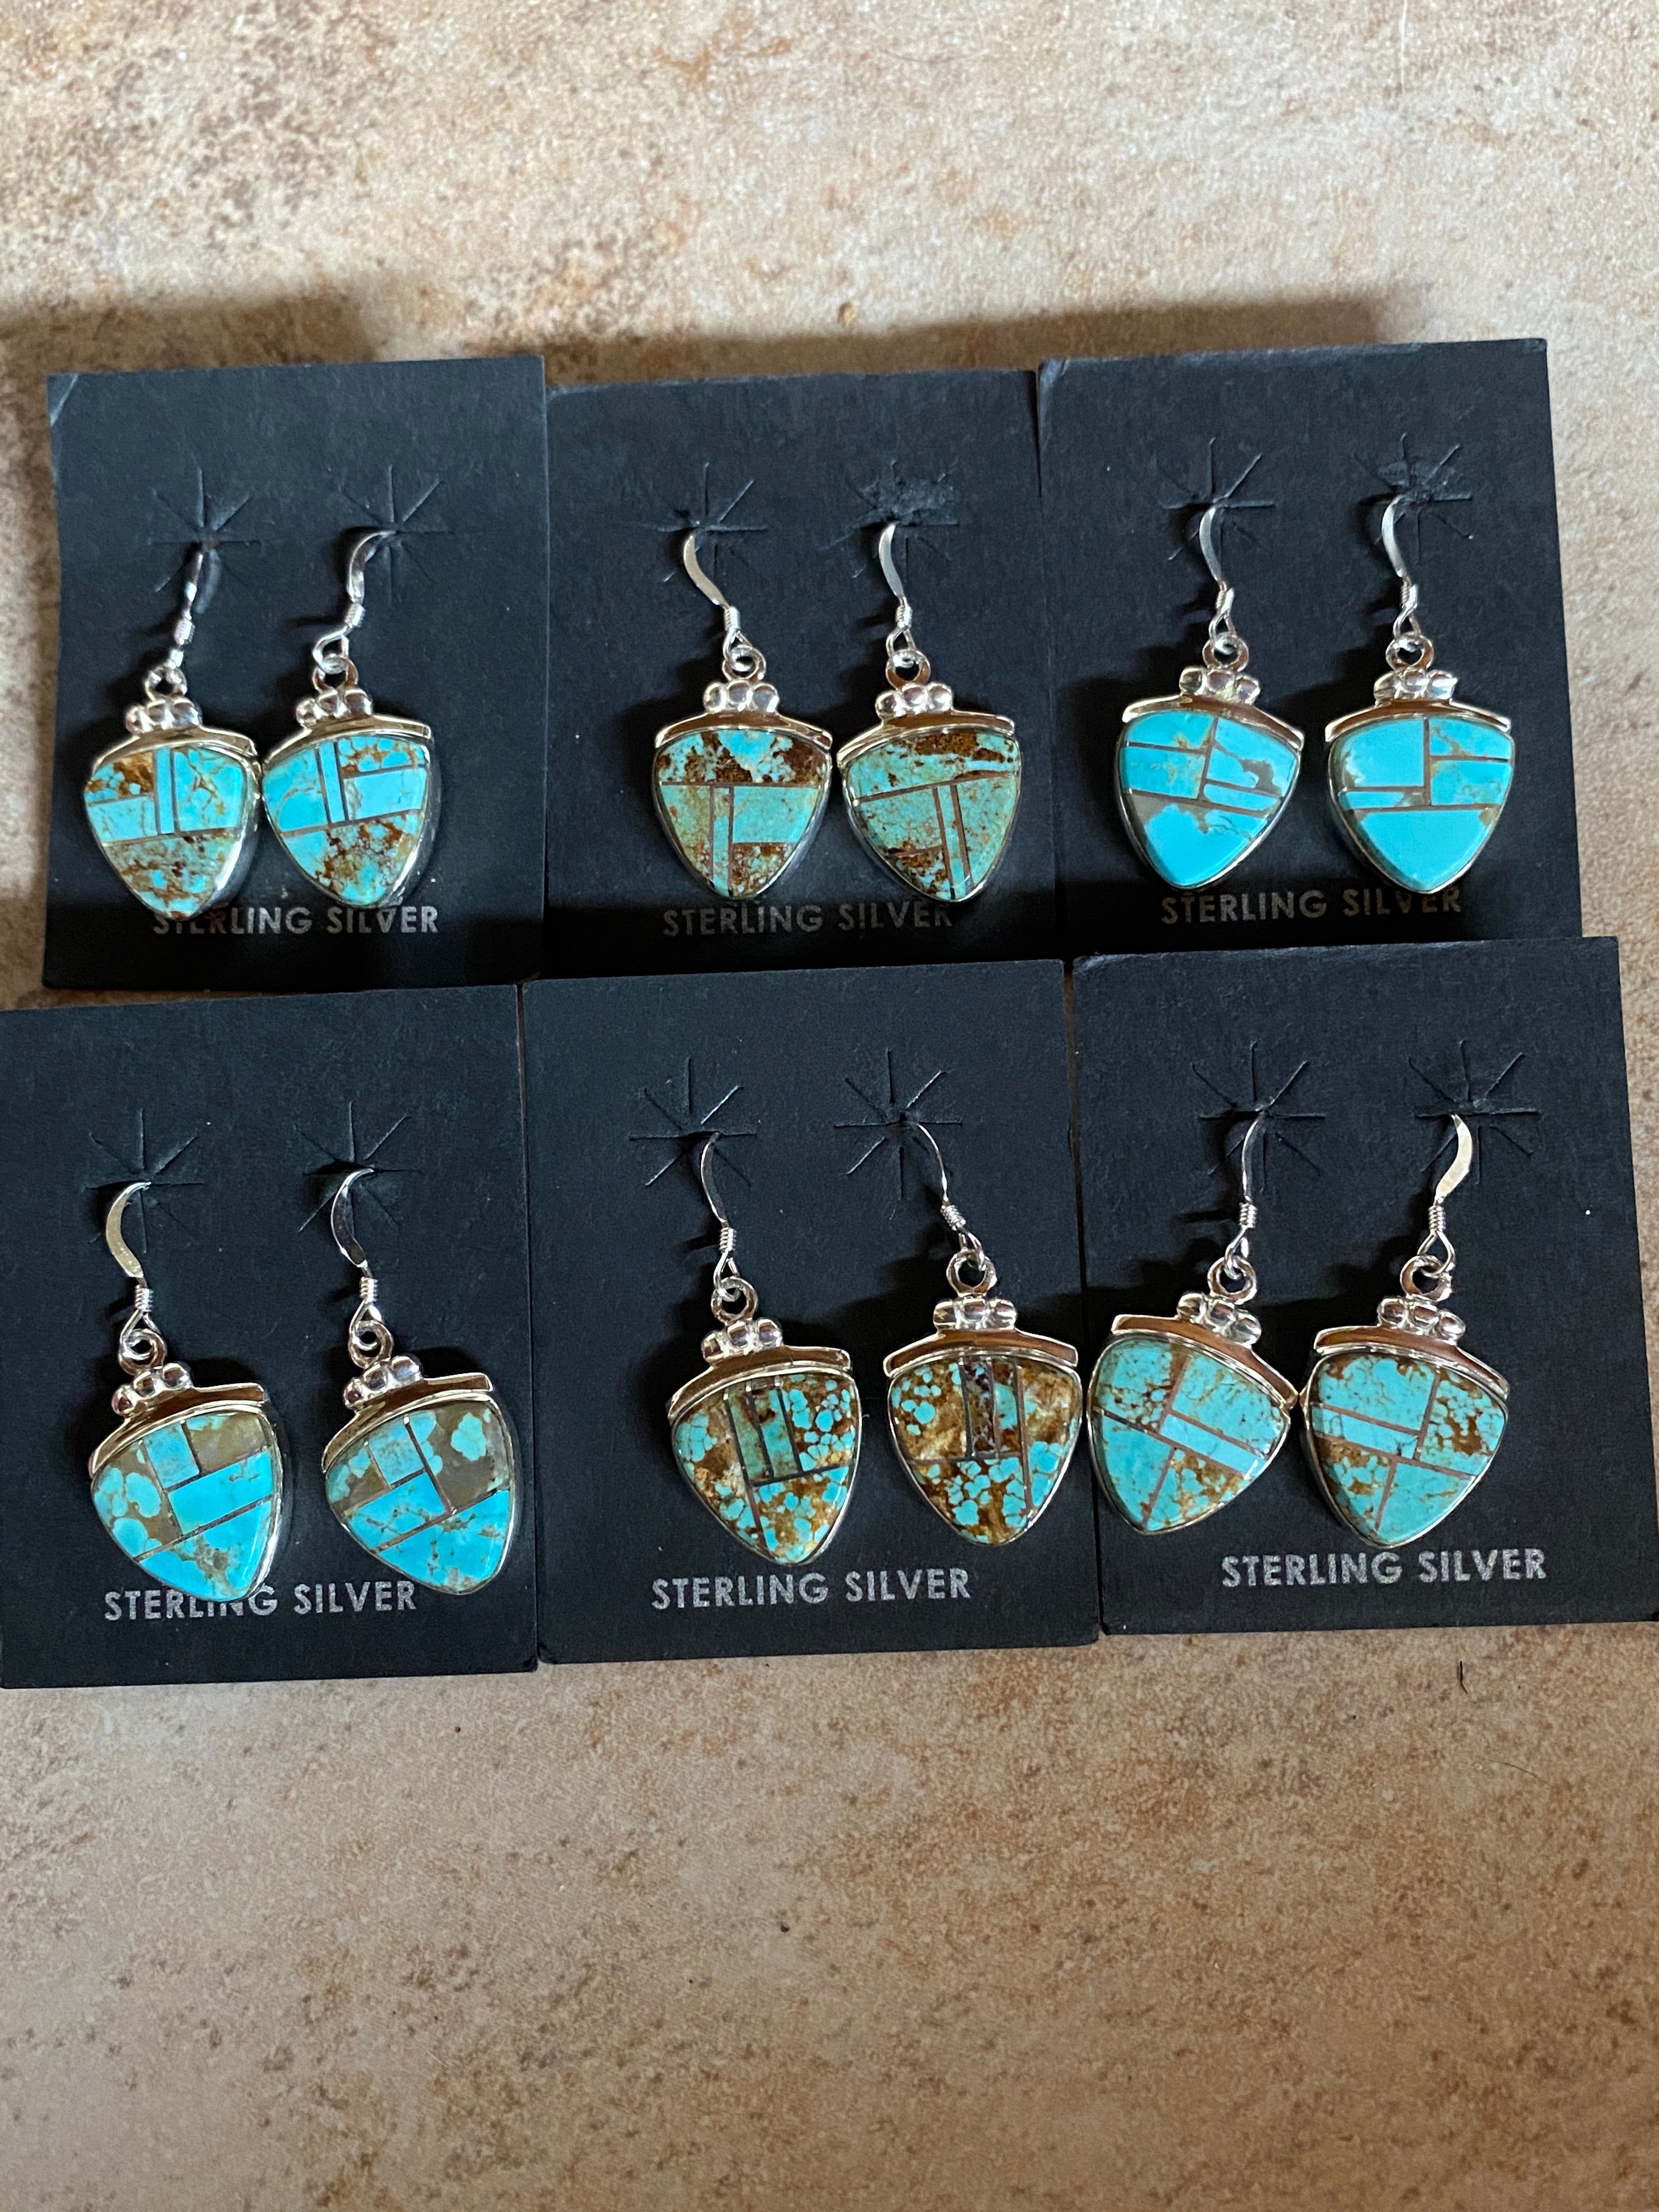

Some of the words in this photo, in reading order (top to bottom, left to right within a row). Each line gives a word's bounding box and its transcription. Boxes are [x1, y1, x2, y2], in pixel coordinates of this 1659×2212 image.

[326, 906, 438, 934] SILVER
[663, 905, 823, 936] STERLING
[838, 901, 953, 930] SILVER
[1161, 889, 1327, 924] STERLING
[1343, 886, 1461, 916] SILVER
[1221, 1551, 1403, 1587] STERLING
[1418, 1548, 1547, 1583] SILVER
[294, 1581, 416, 1615] SILVER
[651, 1572, 828, 1610] STERLING
[844, 1568, 970, 1602] SILVER
